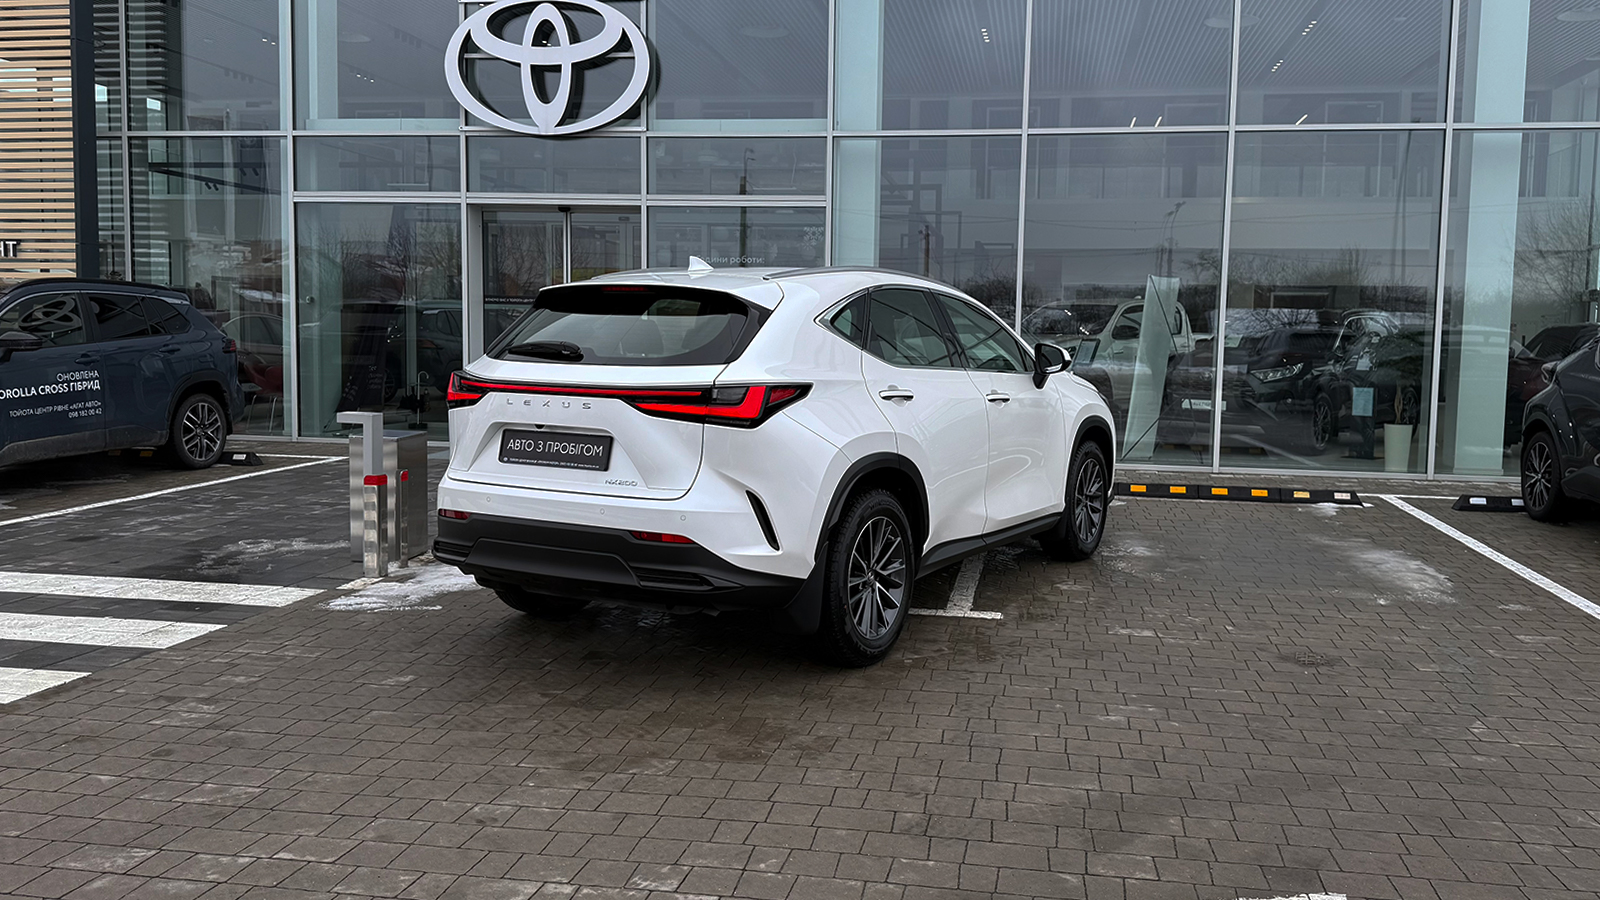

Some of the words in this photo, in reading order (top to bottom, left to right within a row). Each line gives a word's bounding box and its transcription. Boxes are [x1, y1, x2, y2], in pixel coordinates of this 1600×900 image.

[697, 254, 728, 264] одини
[730, 254, 765, 265] роботи:
[56, 370, 100, 381] ОНОВЛЕНА
[38, 383, 69, 395] CROSS
[70, 380, 101, 391] ГІБРИД
[9, 409, 34, 418] ТОЙОТА
[34, 406, 53, 415] ЦЕНТР
[53, 403, 69, 412] РІВНЕ
[506, 398, 592, 410] LEXUS
[507, 438, 535, 452] АВТО
[536, 441, 544, 452] З
[545, 441, 604, 457] ПРОБІГОМ
